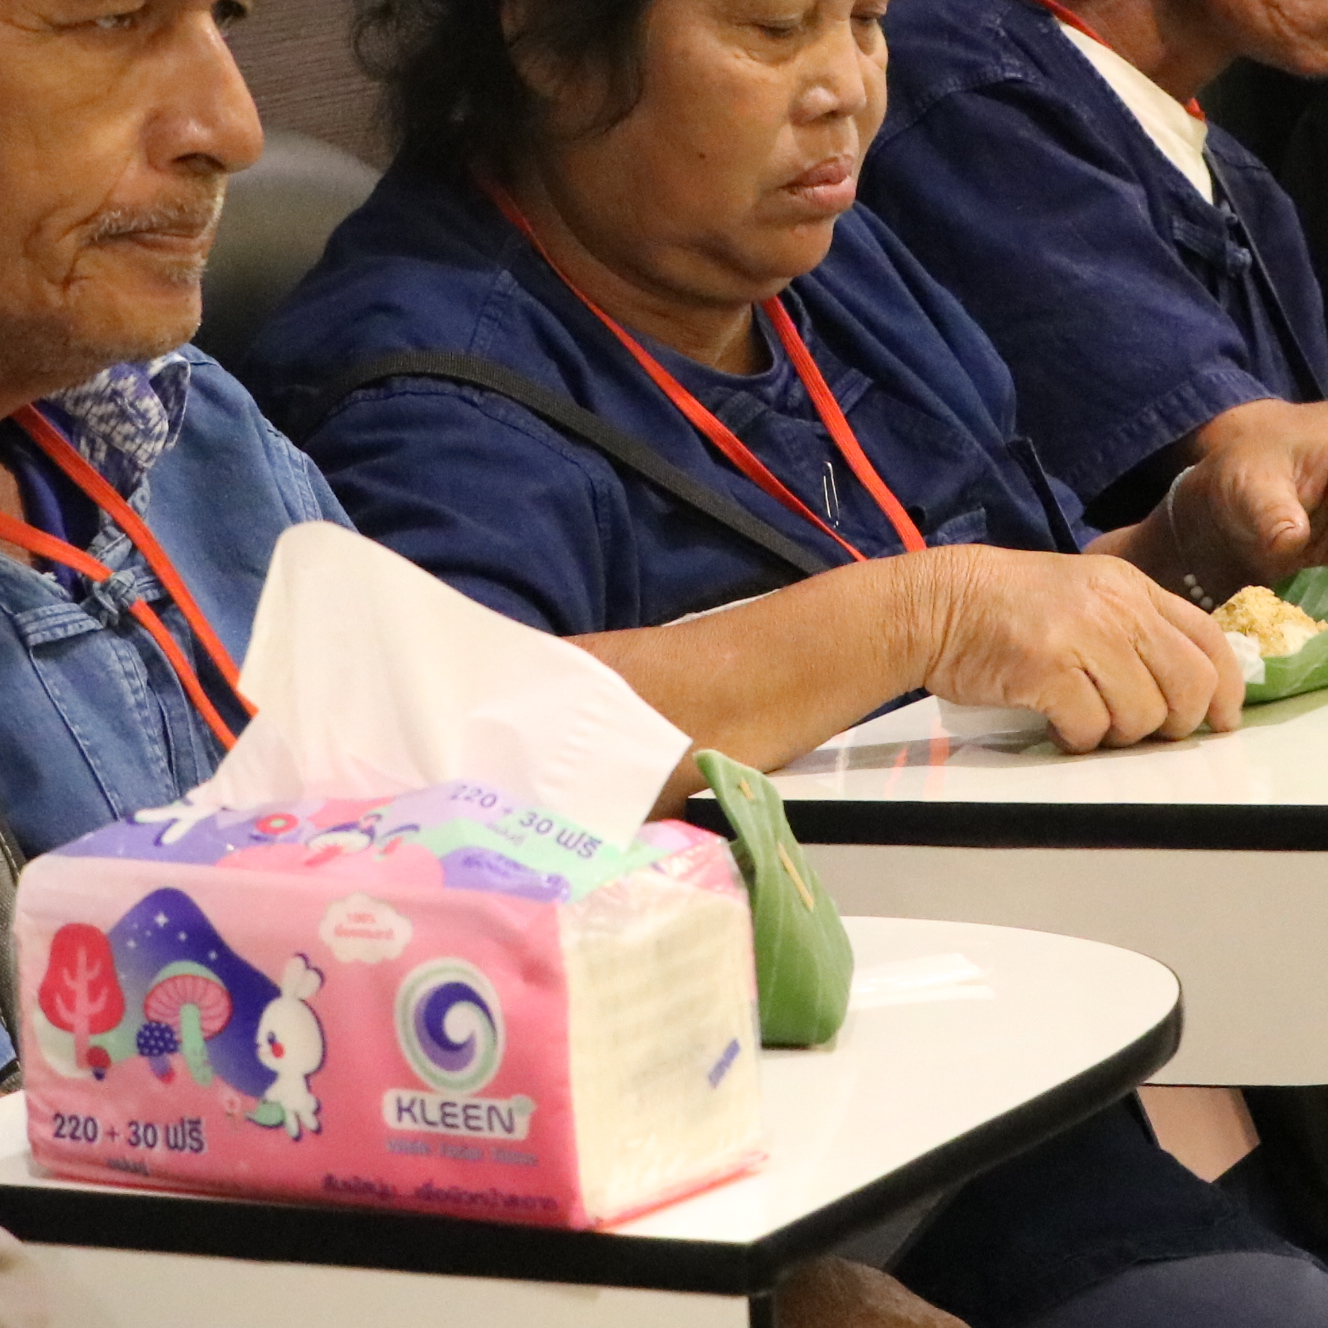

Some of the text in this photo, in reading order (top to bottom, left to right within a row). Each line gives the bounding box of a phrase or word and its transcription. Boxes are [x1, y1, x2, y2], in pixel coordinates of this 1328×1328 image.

[520, 810, 554, 835] 30
[53, 1112, 98, 1143] 220
[127, 1120, 158, 1148] 30
[166, 1117, 205, 1153] ฟรี
[396, 1096, 516, 1134] KLEEN
